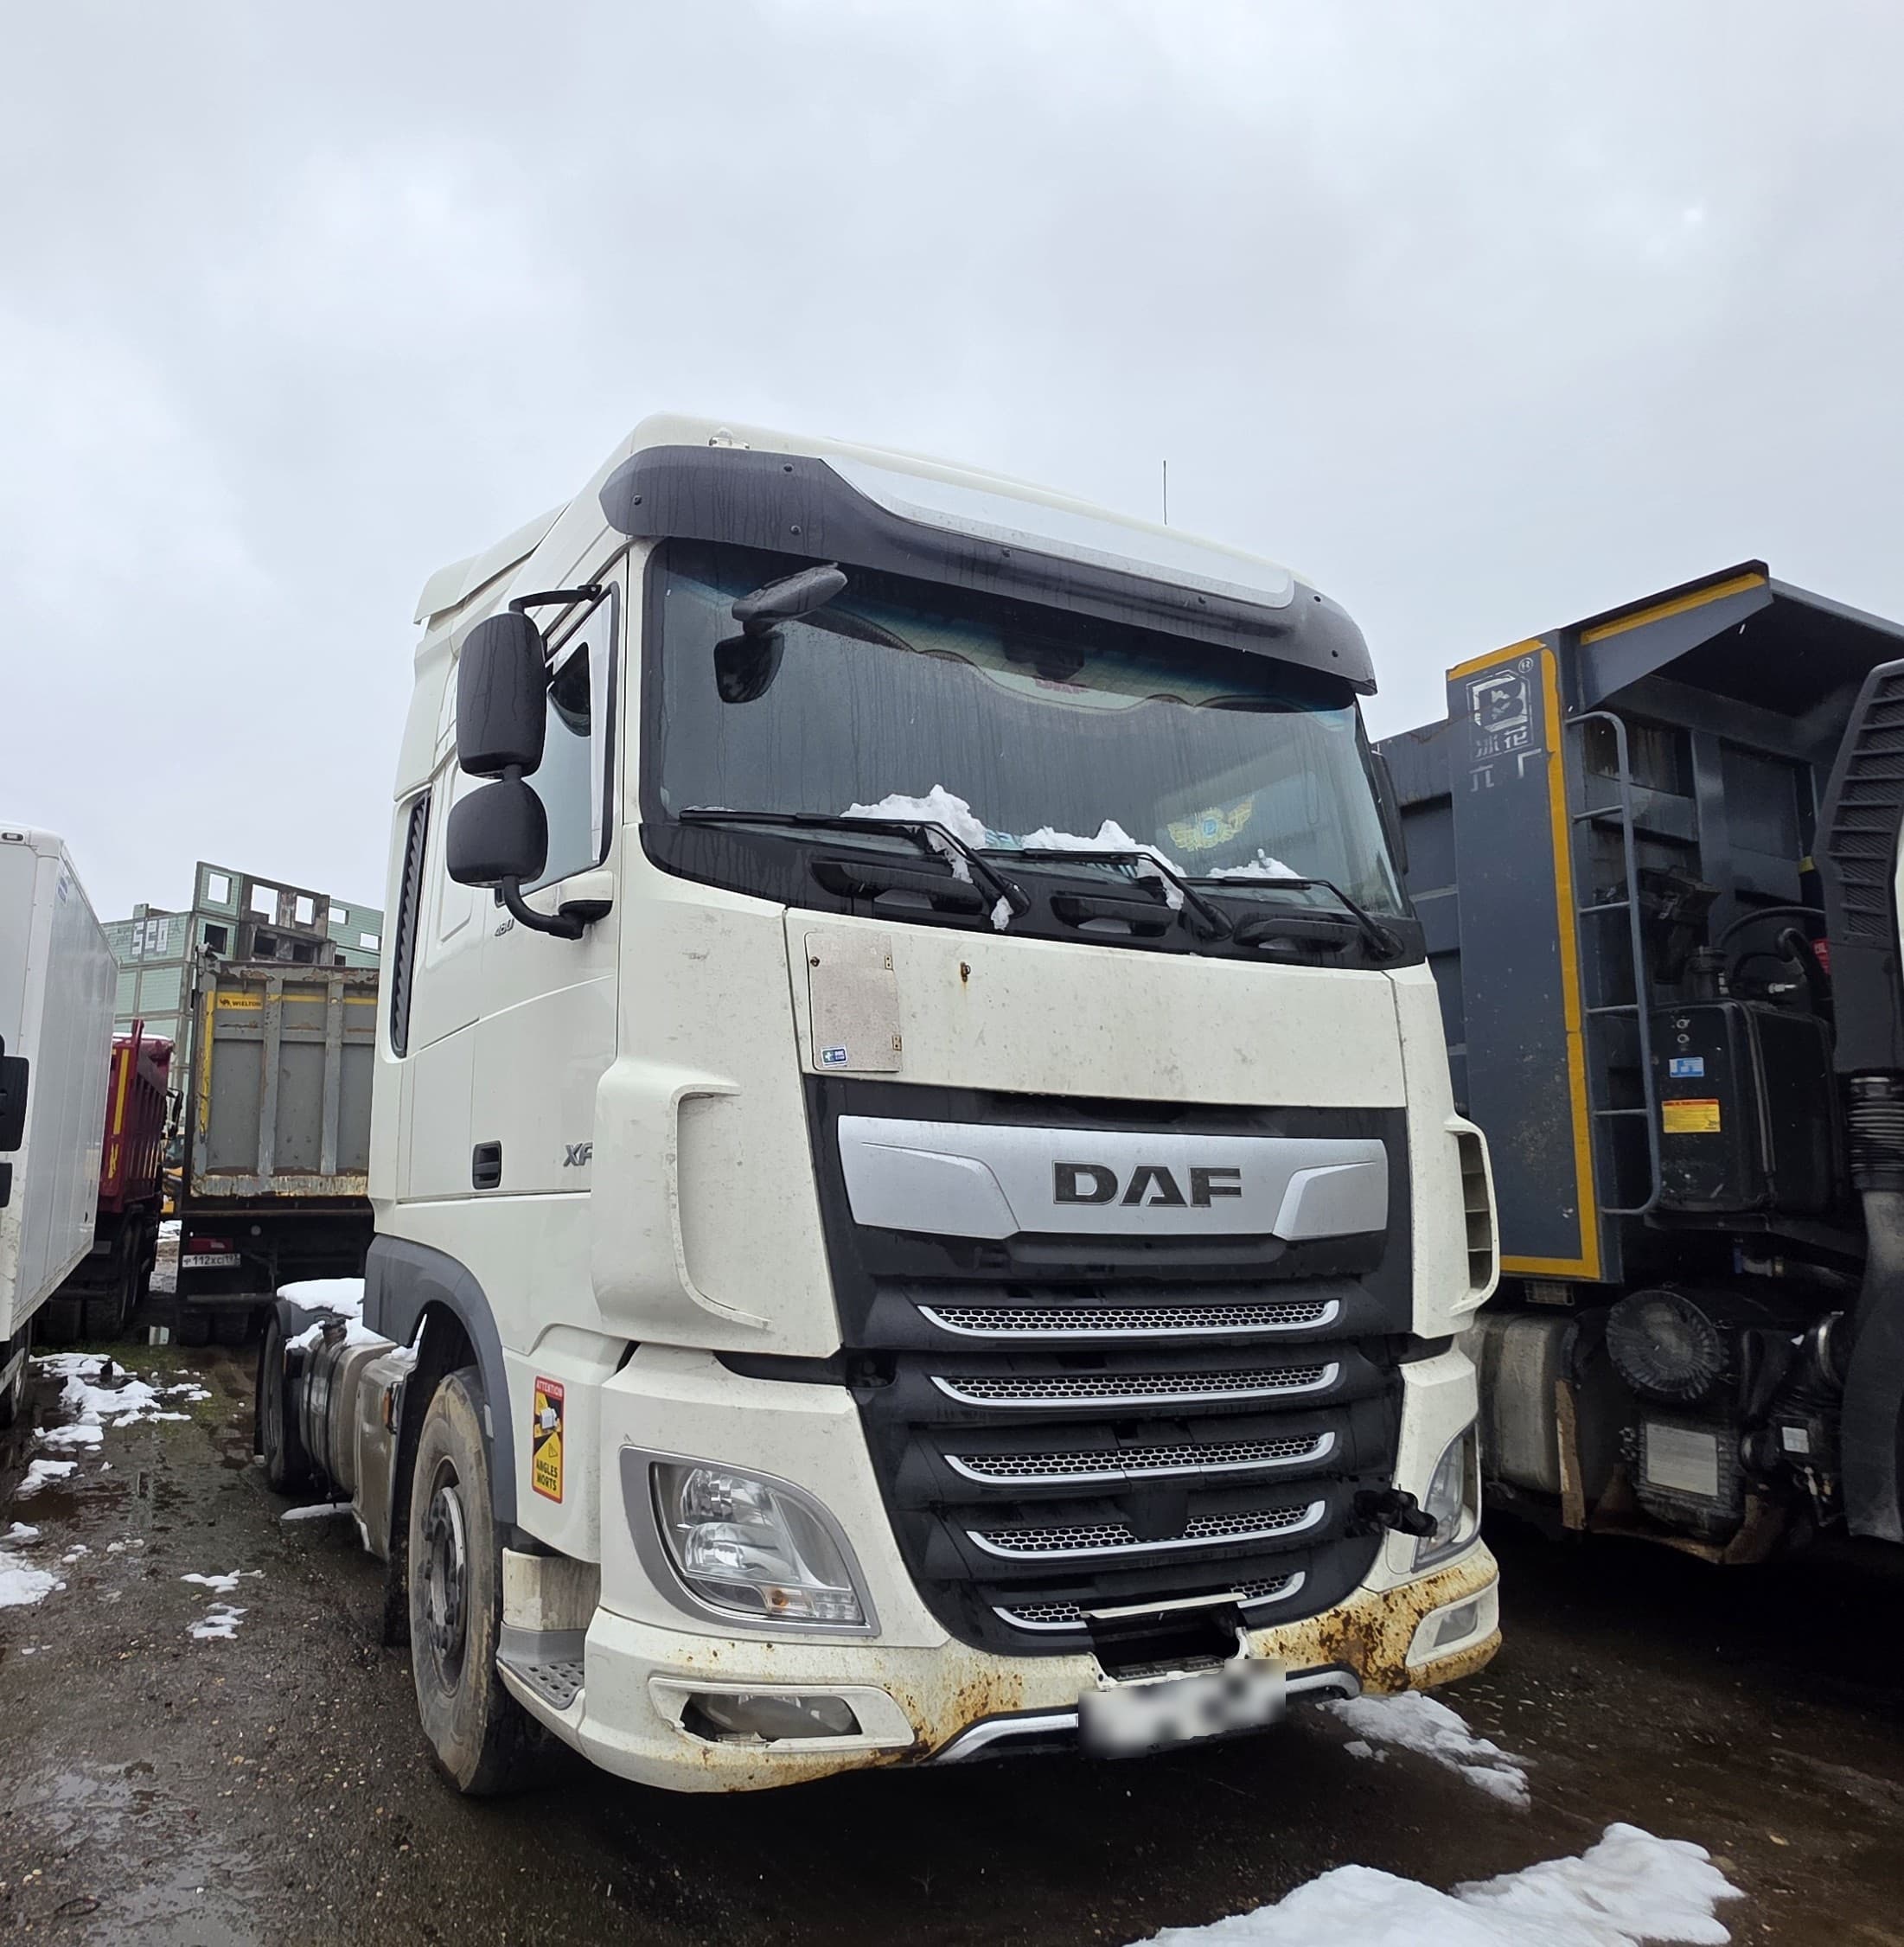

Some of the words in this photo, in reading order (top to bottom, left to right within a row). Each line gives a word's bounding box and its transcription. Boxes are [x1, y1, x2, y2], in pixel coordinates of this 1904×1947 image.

[563, 1142, 593, 1167] XF
[1052, 1160, 1242, 1208] DAF
[536, 1458, 558, 1478] ANGLES
[536, 1471, 557, 1491] MORTS
